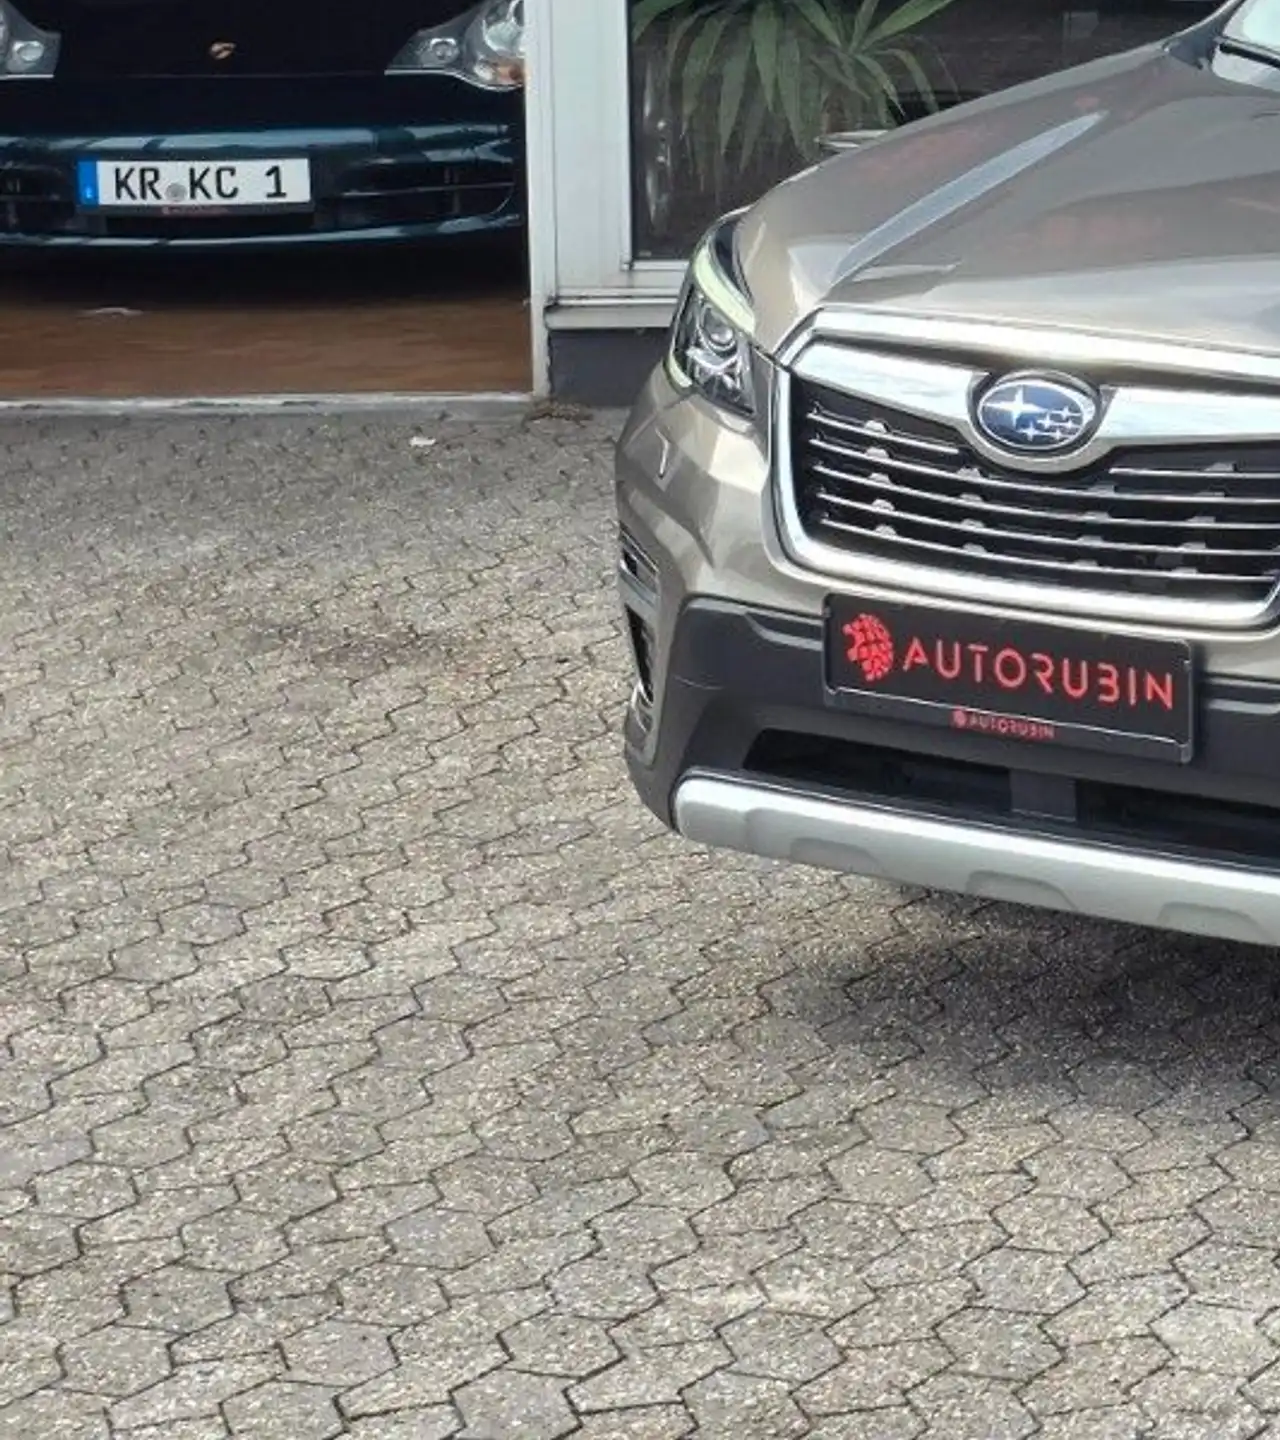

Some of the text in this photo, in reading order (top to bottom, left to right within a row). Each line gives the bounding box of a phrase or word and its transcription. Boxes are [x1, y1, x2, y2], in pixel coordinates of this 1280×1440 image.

[114, 166, 162, 200] KR
[188, 166, 239, 200] KC
[264, 165, 287, 199] 1
[902, 636, 1174, 709] AUTORUBIN
[968, 711, 1056, 739] AUTORUBIN
